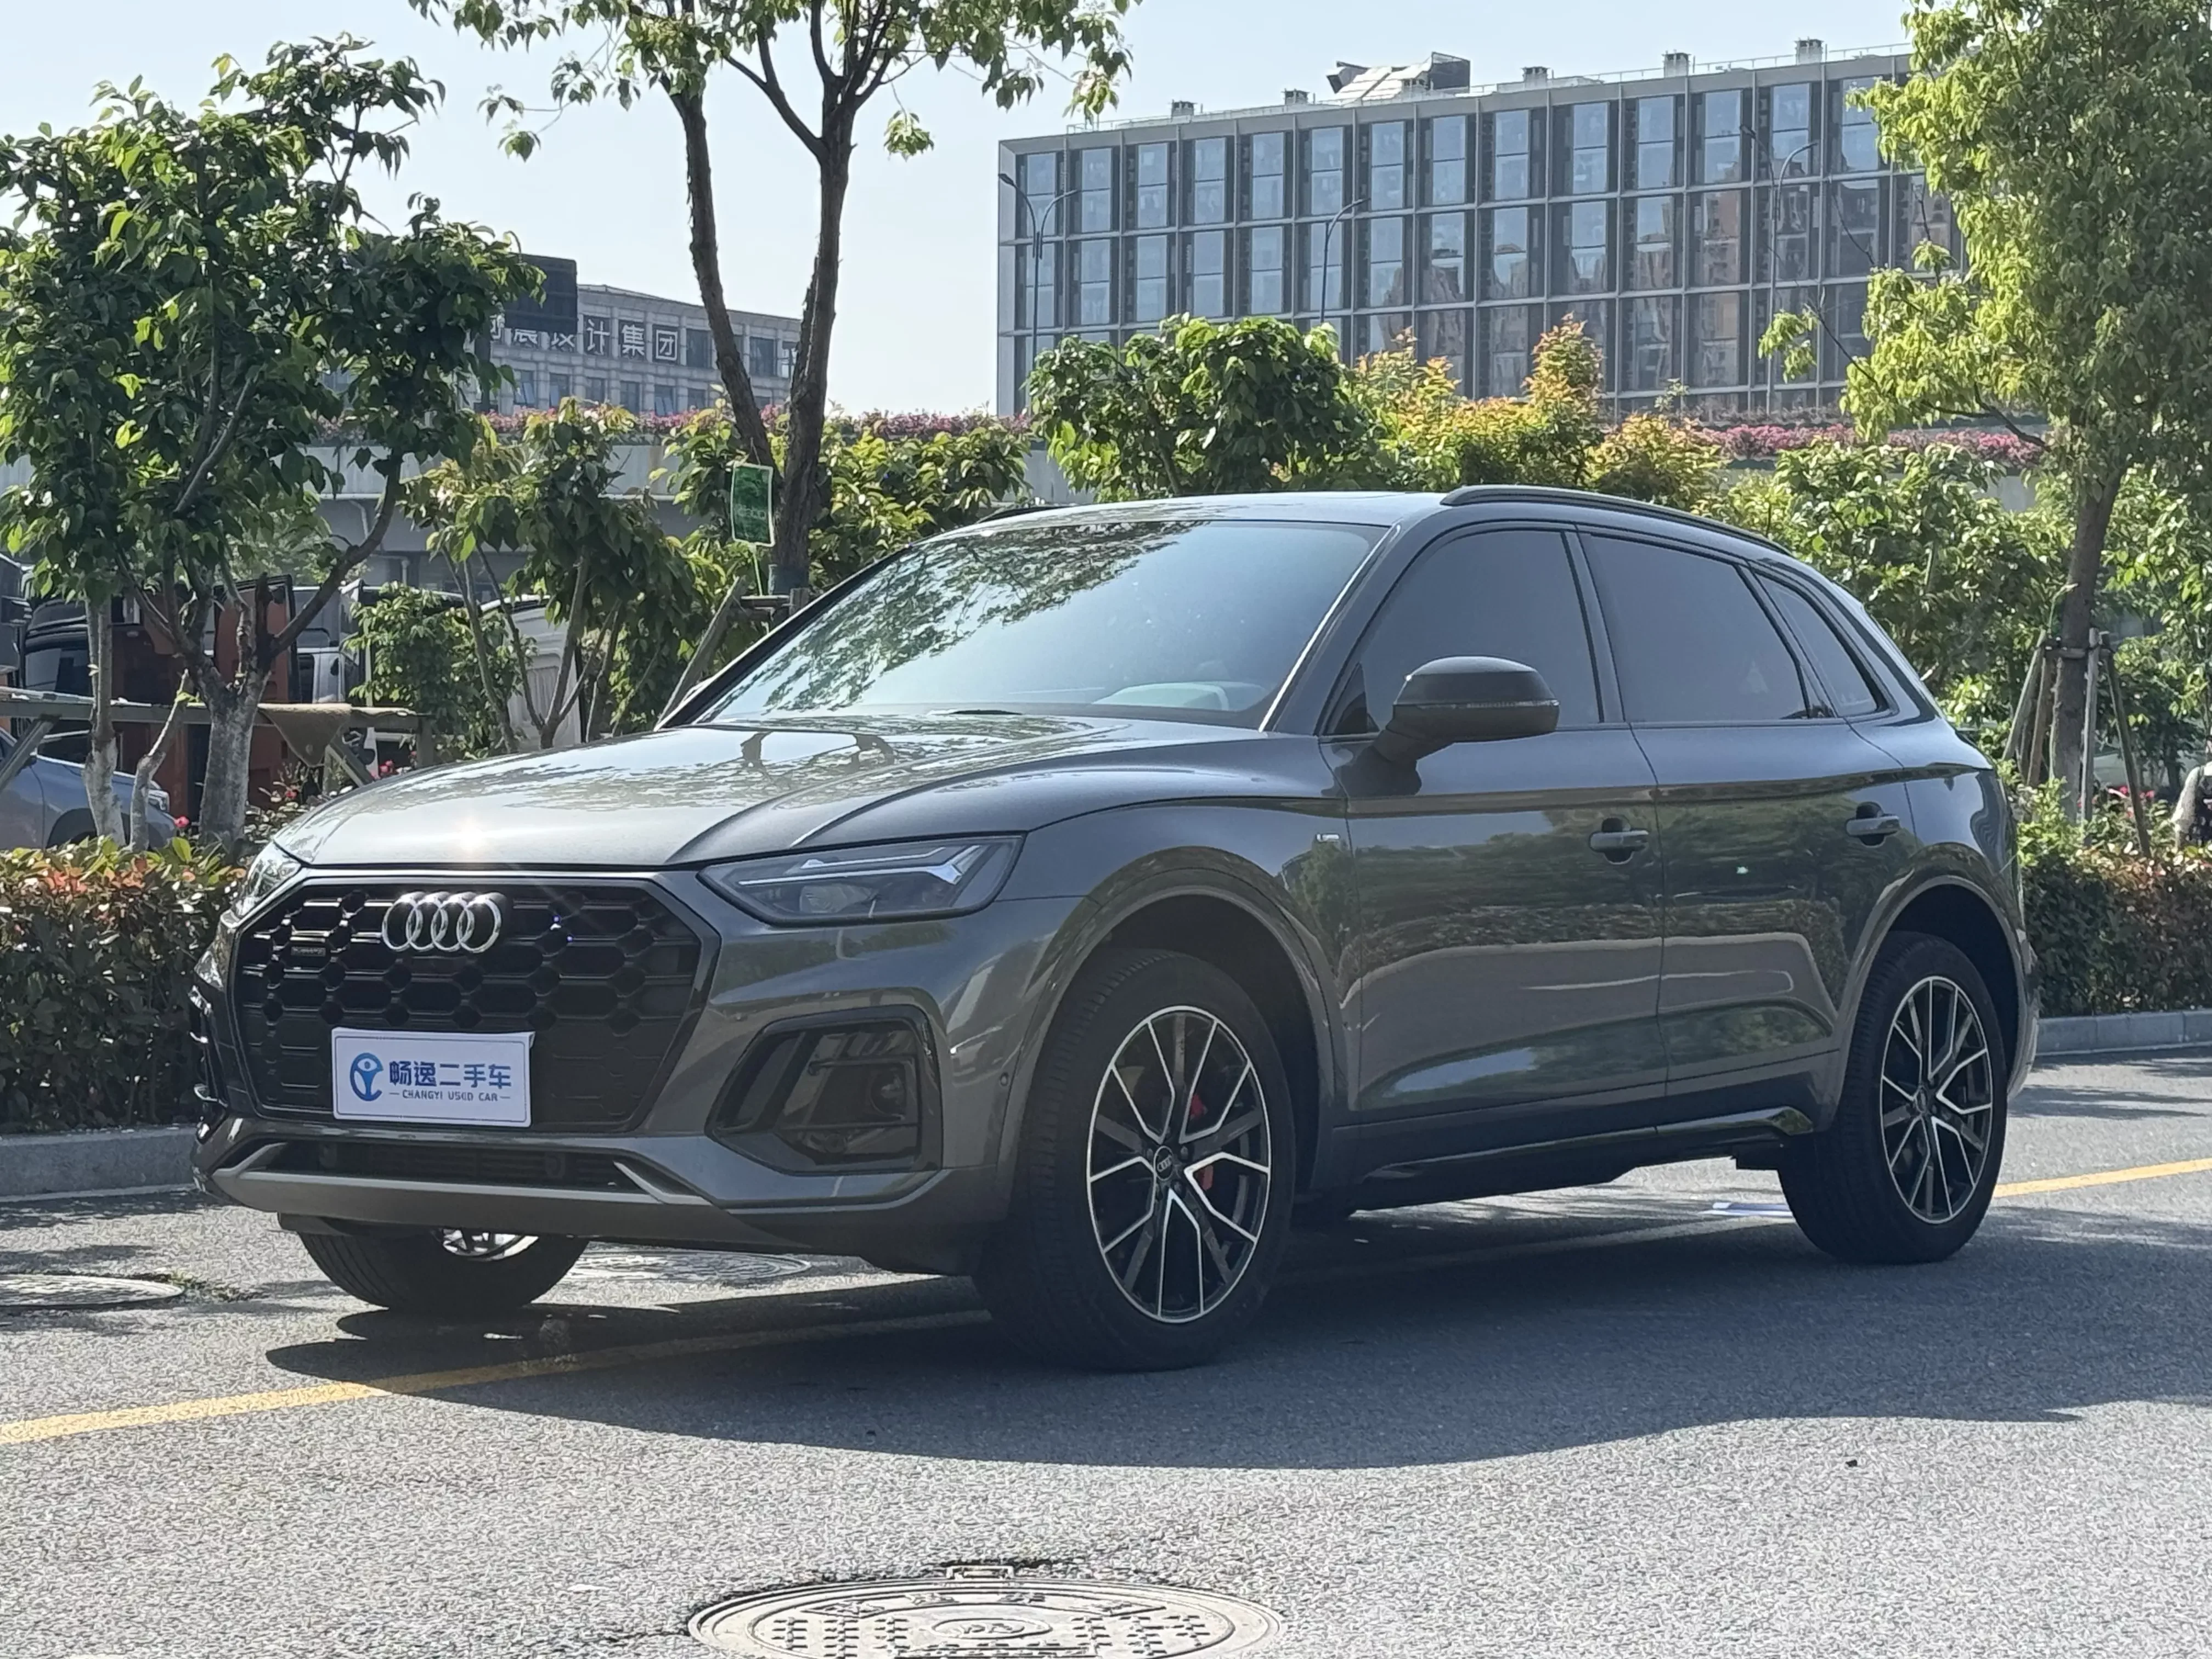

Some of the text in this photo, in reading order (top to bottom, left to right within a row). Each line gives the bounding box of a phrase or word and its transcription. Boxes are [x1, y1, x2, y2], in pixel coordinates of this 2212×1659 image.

[389, 1060, 512, 1089] 畅逸二手车
[402, 1089, 443, 1099] CHANGYI
[478, 1092, 498, 1102] CAR
